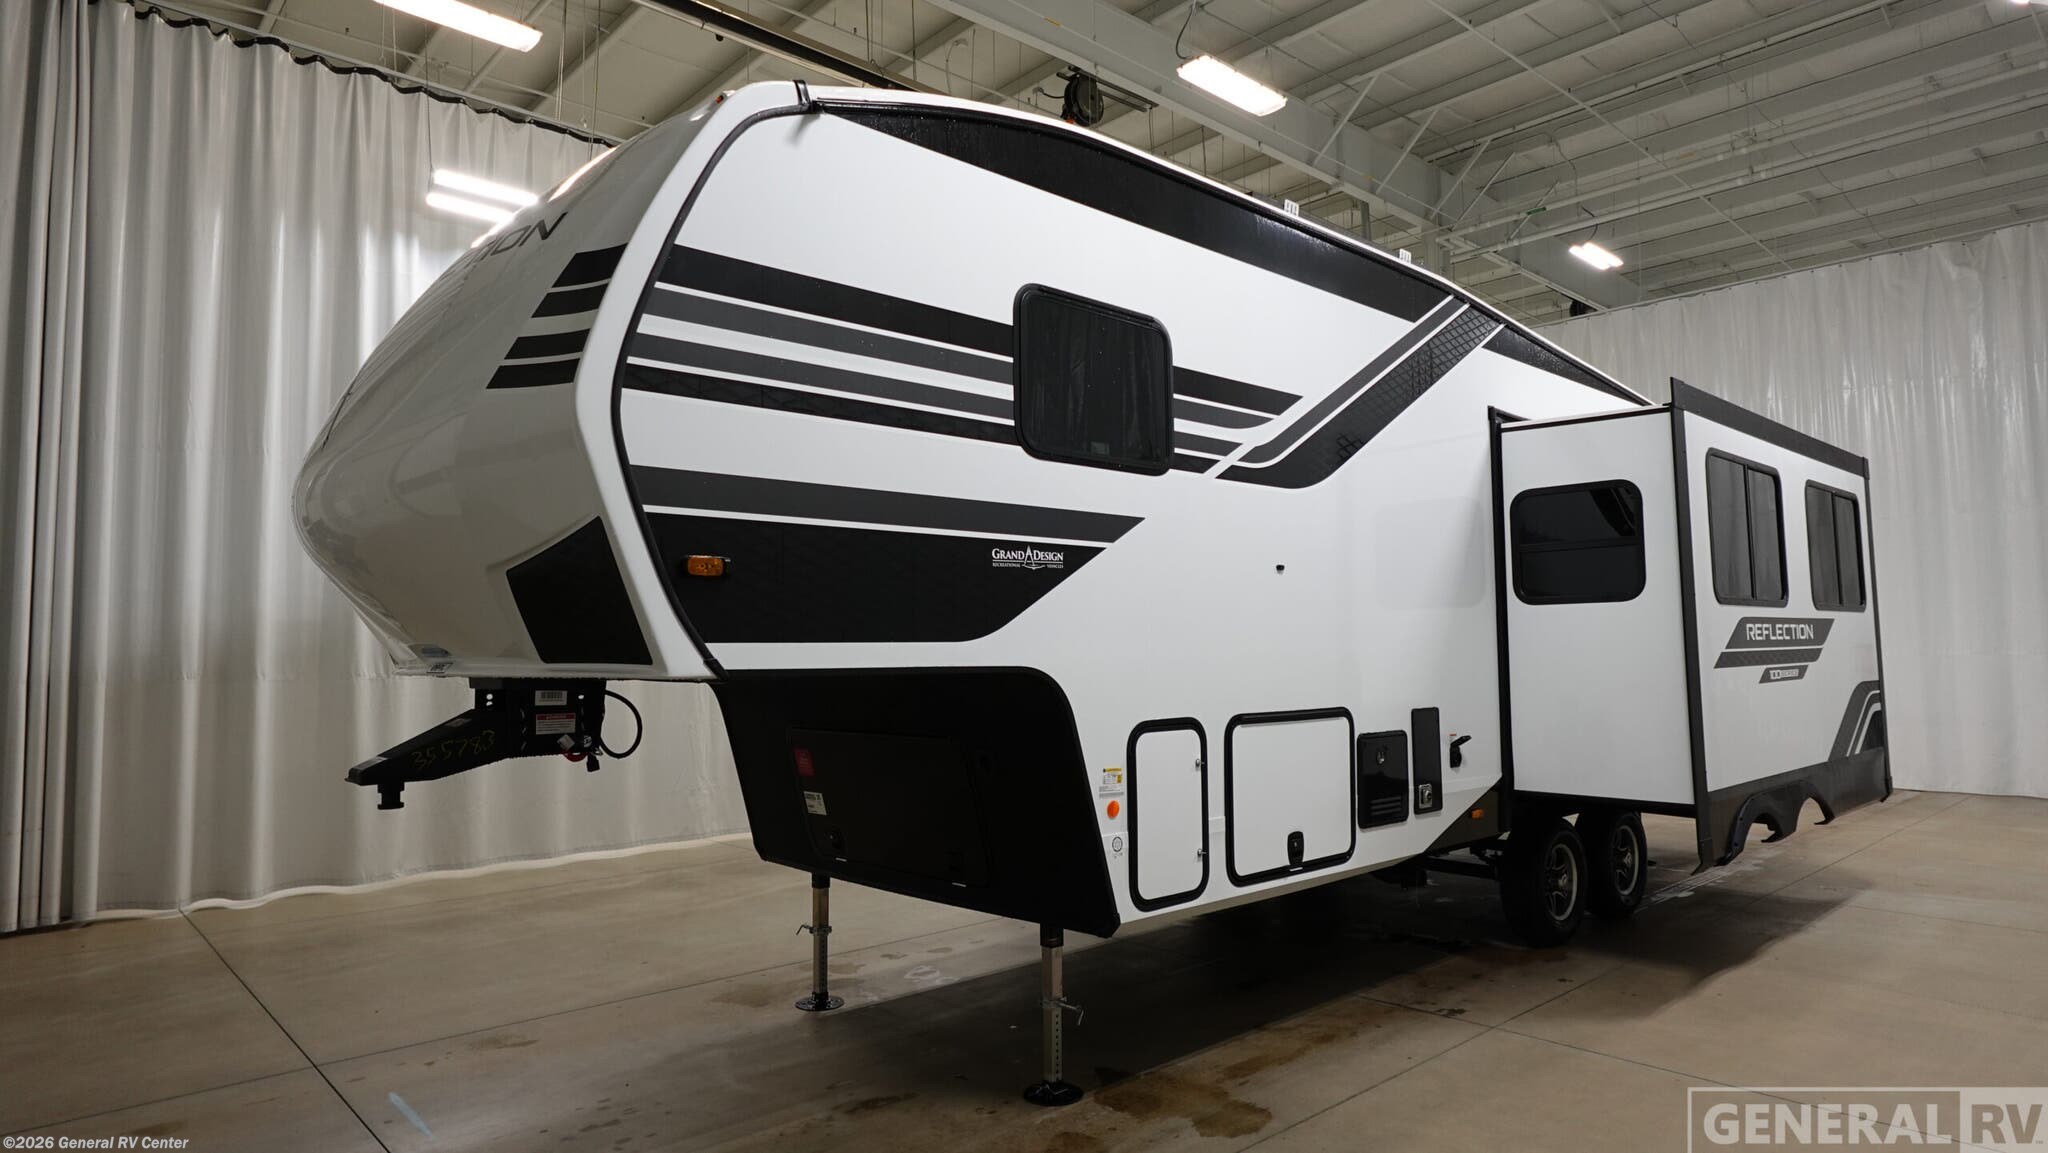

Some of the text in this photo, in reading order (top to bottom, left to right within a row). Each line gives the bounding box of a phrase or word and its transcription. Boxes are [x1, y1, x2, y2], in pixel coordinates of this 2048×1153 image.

[991, 548, 1064, 561] GRAND DESIGN
[1746, 623, 1814, 640] REFLECTION
